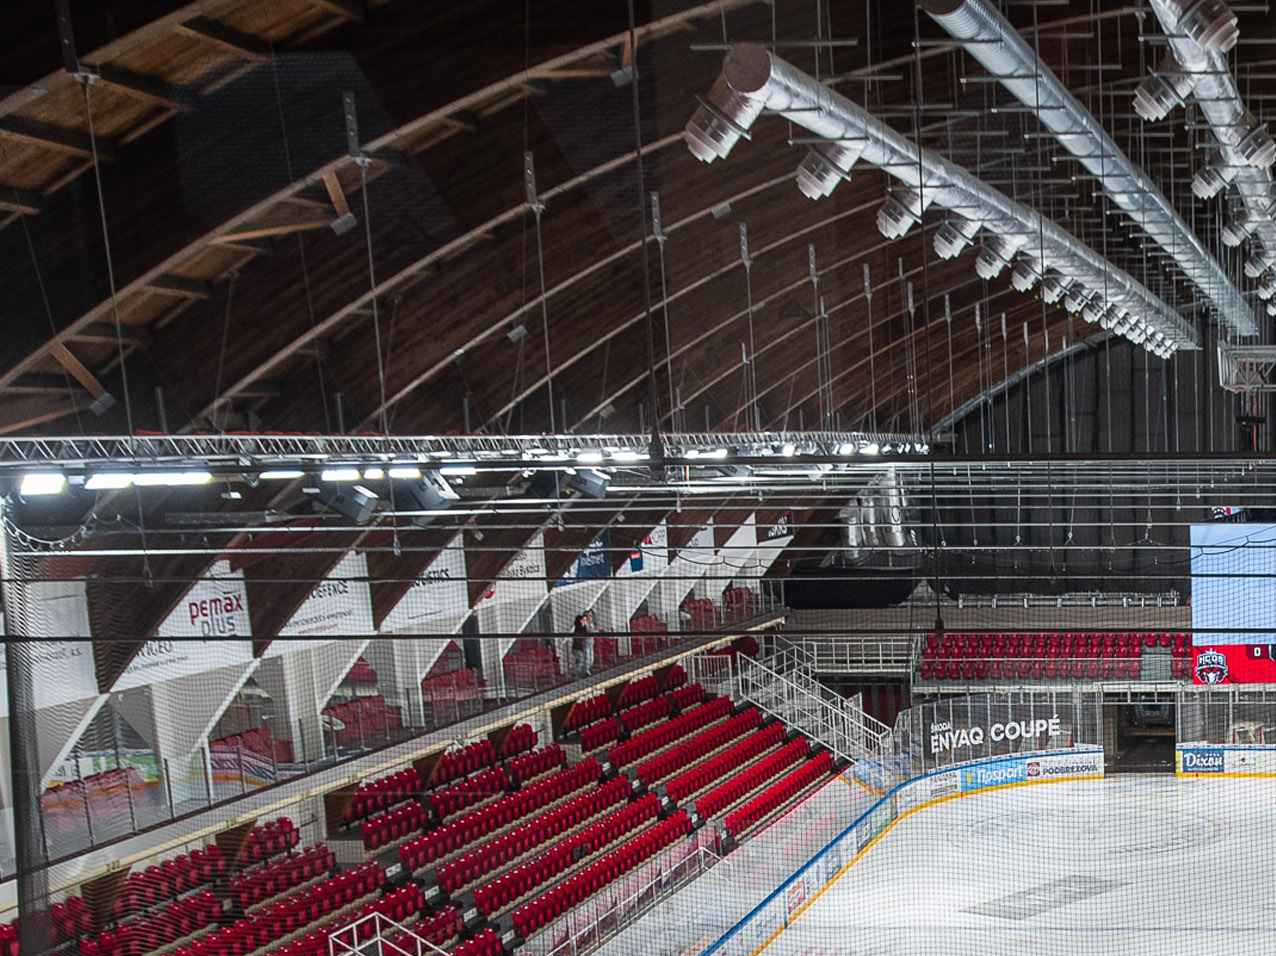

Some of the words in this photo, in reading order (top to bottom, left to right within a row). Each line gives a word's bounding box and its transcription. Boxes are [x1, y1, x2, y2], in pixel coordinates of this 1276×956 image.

[200, 614, 236, 643] plus
[1253, 647, 1262, 657] 0
[931, 726, 984, 754] ENYAQ
[990, 713, 1061, 742] COUPÉ
